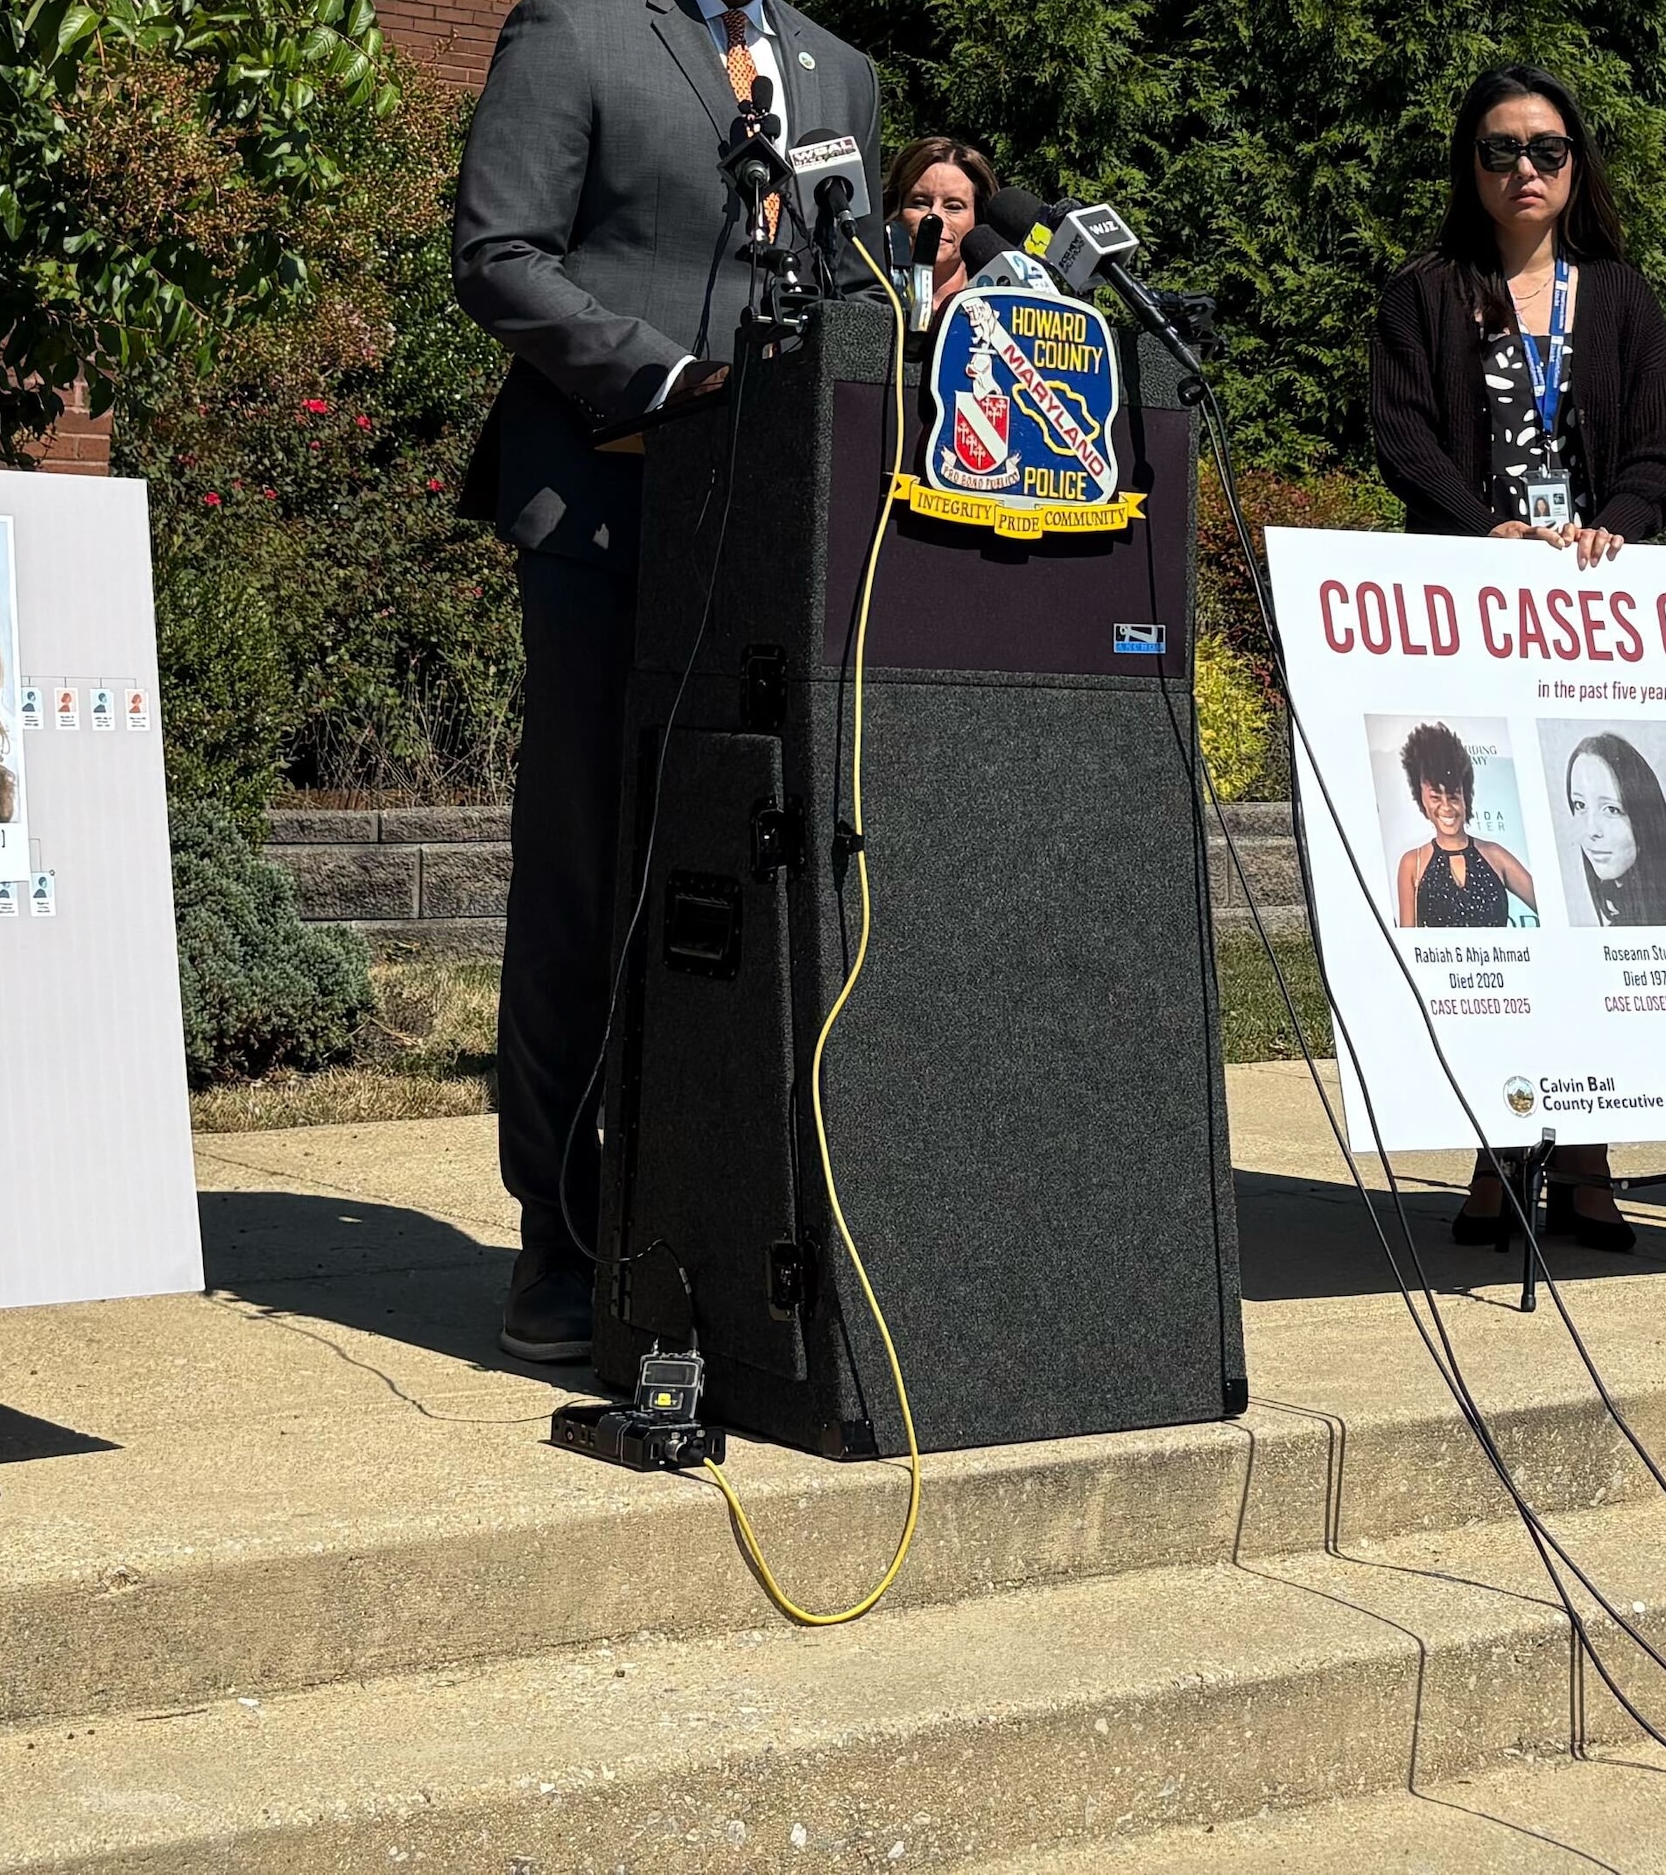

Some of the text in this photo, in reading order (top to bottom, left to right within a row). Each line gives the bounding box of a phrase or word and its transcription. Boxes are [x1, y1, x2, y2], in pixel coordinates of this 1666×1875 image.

[1089, 220, 1120, 236] WJZ
[1011, 306, 1087, 343] HOWARD
[1033, 340, 1104, 375] COUNTY
[1002, 343, 1105, 478] MARYLAND
[1023, 466, 1088, 501] POLICE
[916, 492, 1126, 533] INTEGRITY PRIDE COMMUNITY
[1319, 579, 1461, 656] COLD
[1478, 585, 1644, 662] CASES
[1537, 679, 1550, 698] in
[1553, 680, 1575, 698] the
[1579, 682, 1608, 702] past
[1612, 681, 1637, 700] five
[1414, 946, 1531, 966] Rabiah & Ahja Ahmad
[1603, 945, 1651, 961] Roseann
[1449, 972, 1504, 989] Died 2020
[1623, 970, 1648, 986] Died
[1430, 998, 1531, 1015] CASE CLOSED 2025
[1604, 996, 1632, 1012] CASE
[1539, 1076, 1615, 1093] Calvin Ball
[1542, 1093, 1665, 1114] County Executive
